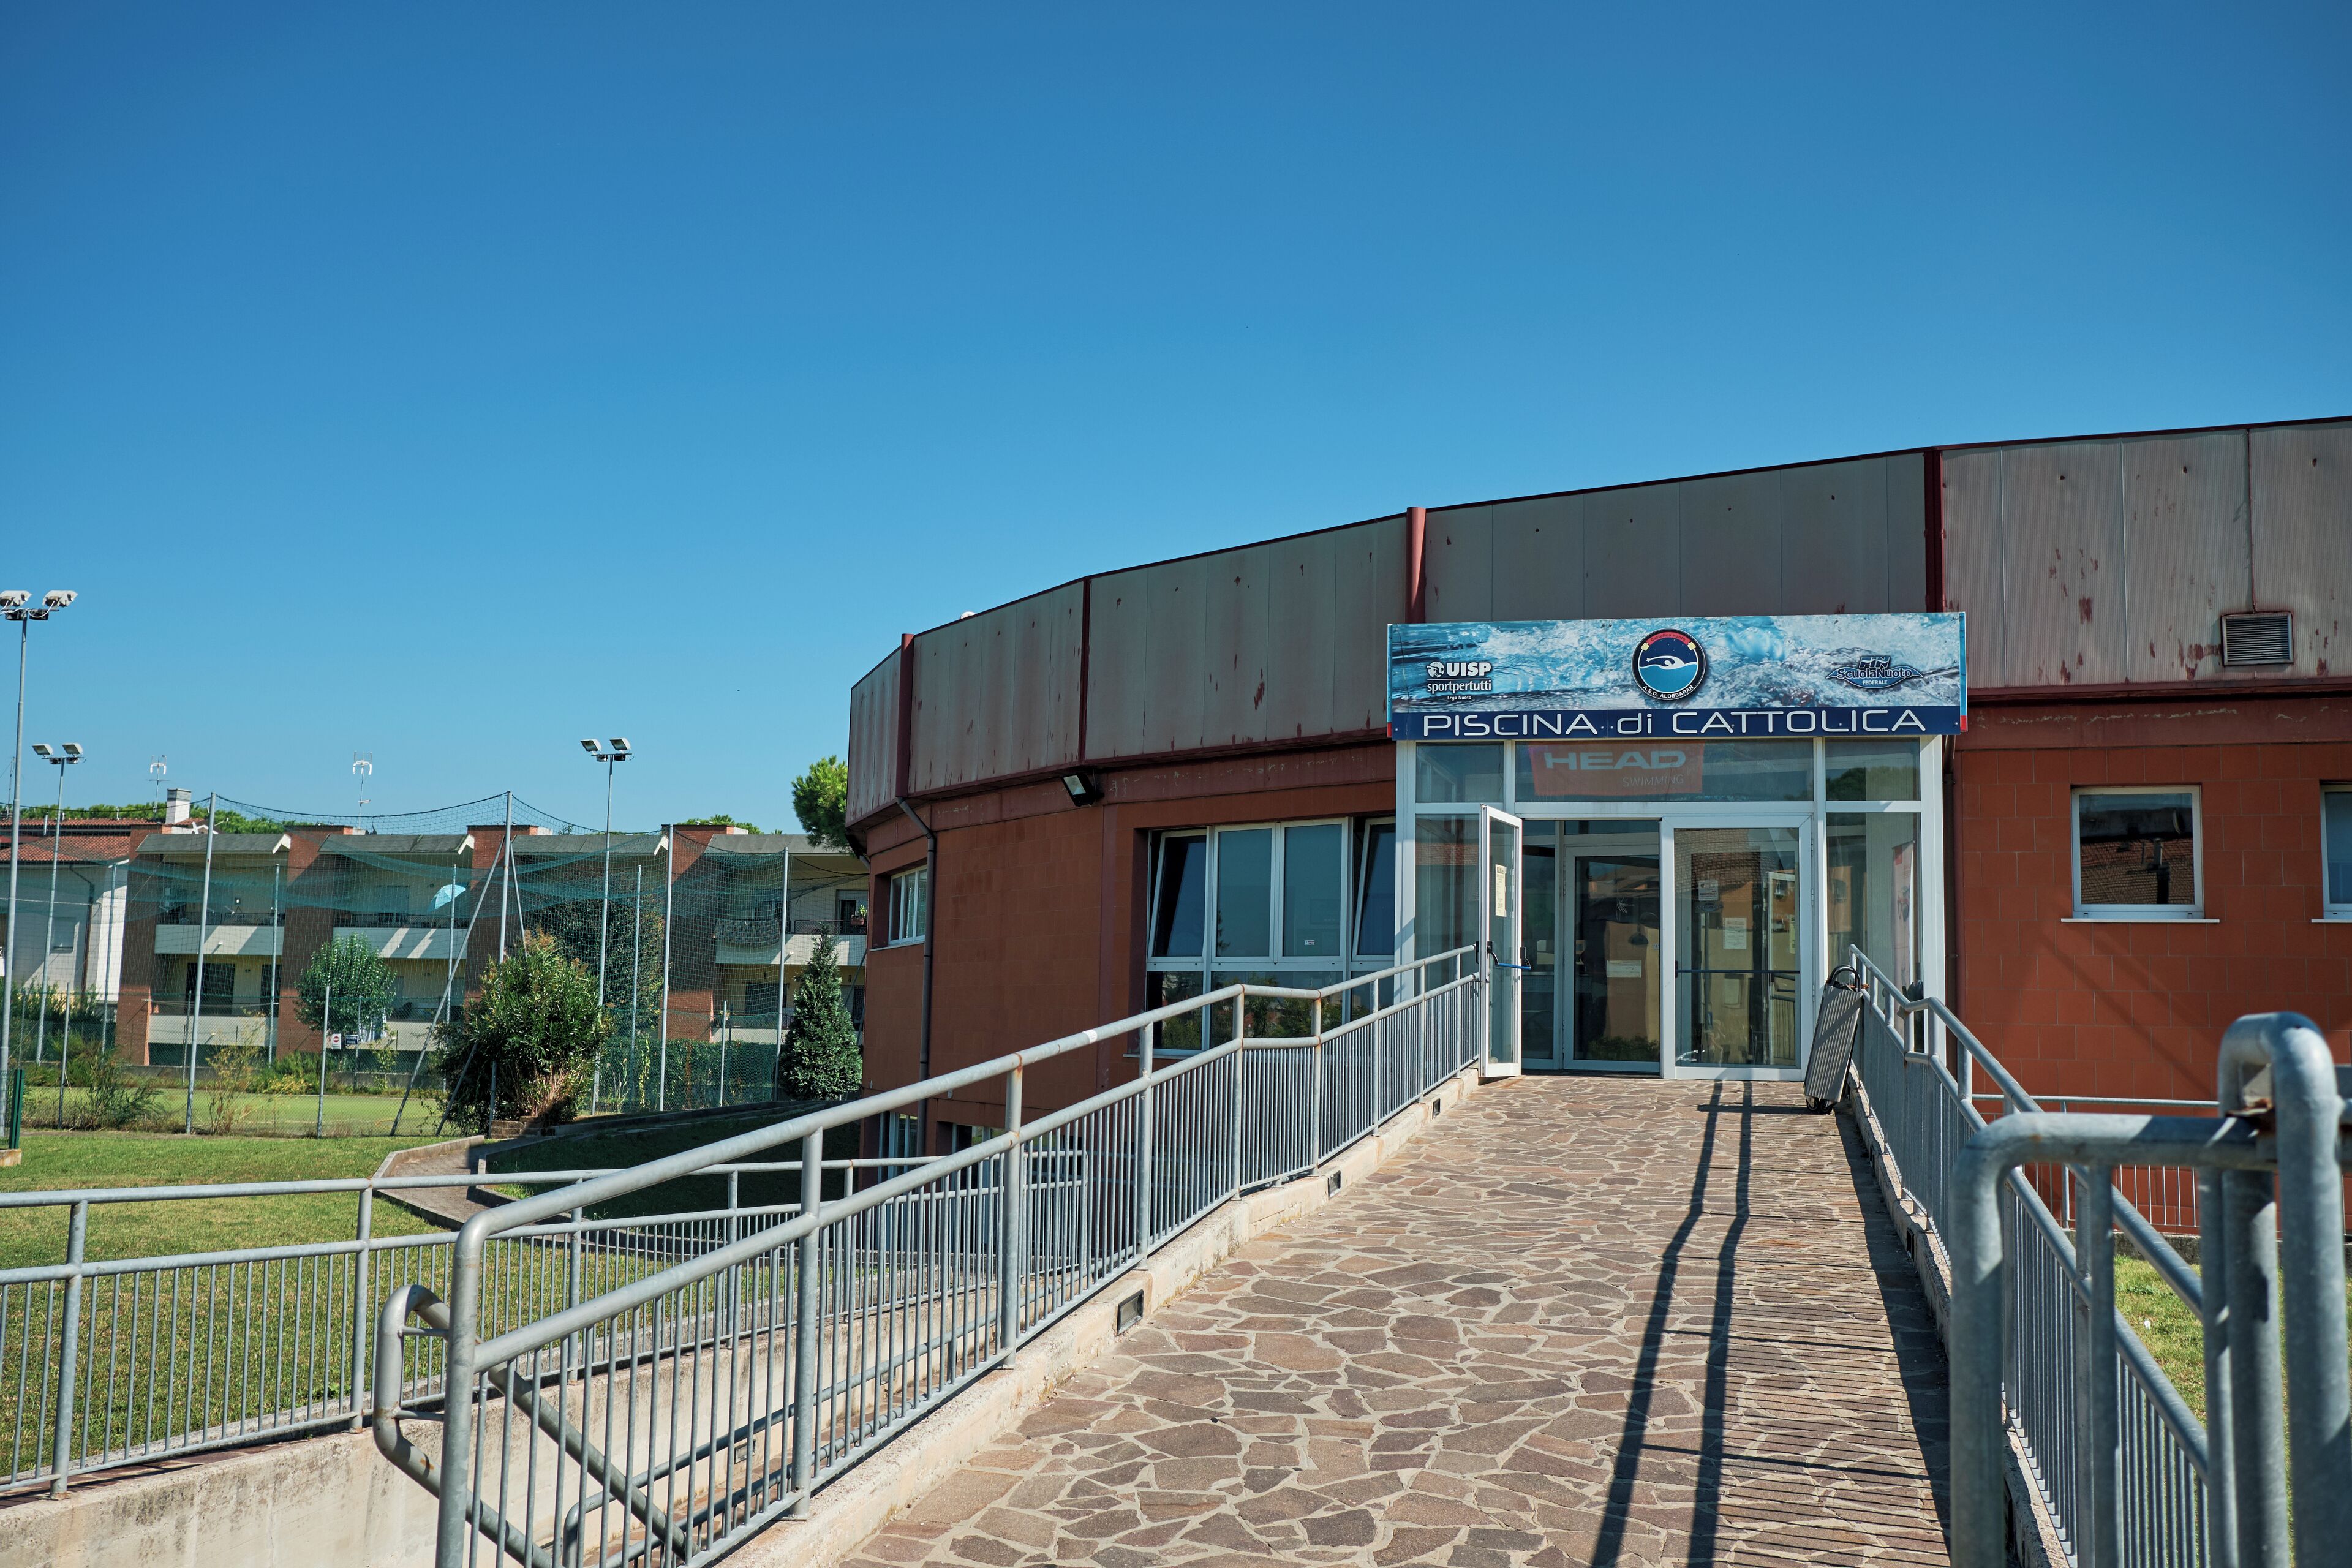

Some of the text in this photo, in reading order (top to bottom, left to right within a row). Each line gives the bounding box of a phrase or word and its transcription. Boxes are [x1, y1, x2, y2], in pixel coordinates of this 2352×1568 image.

[1446, 662, 1491, 676] UISP
[1837, 667, 1913, 679] ScuolaNuoto
[1427, 680, 1491, 694] sportpertutti
[1642, 685, 1694, 698] A.S.D. ALDEBARAN
[1423, 709, 1926, 736] PISCINA di CATTOLICA
[1544, 750, 1686, 770] HEAD
[1622, 774, 1684, 788] SWIMMING
